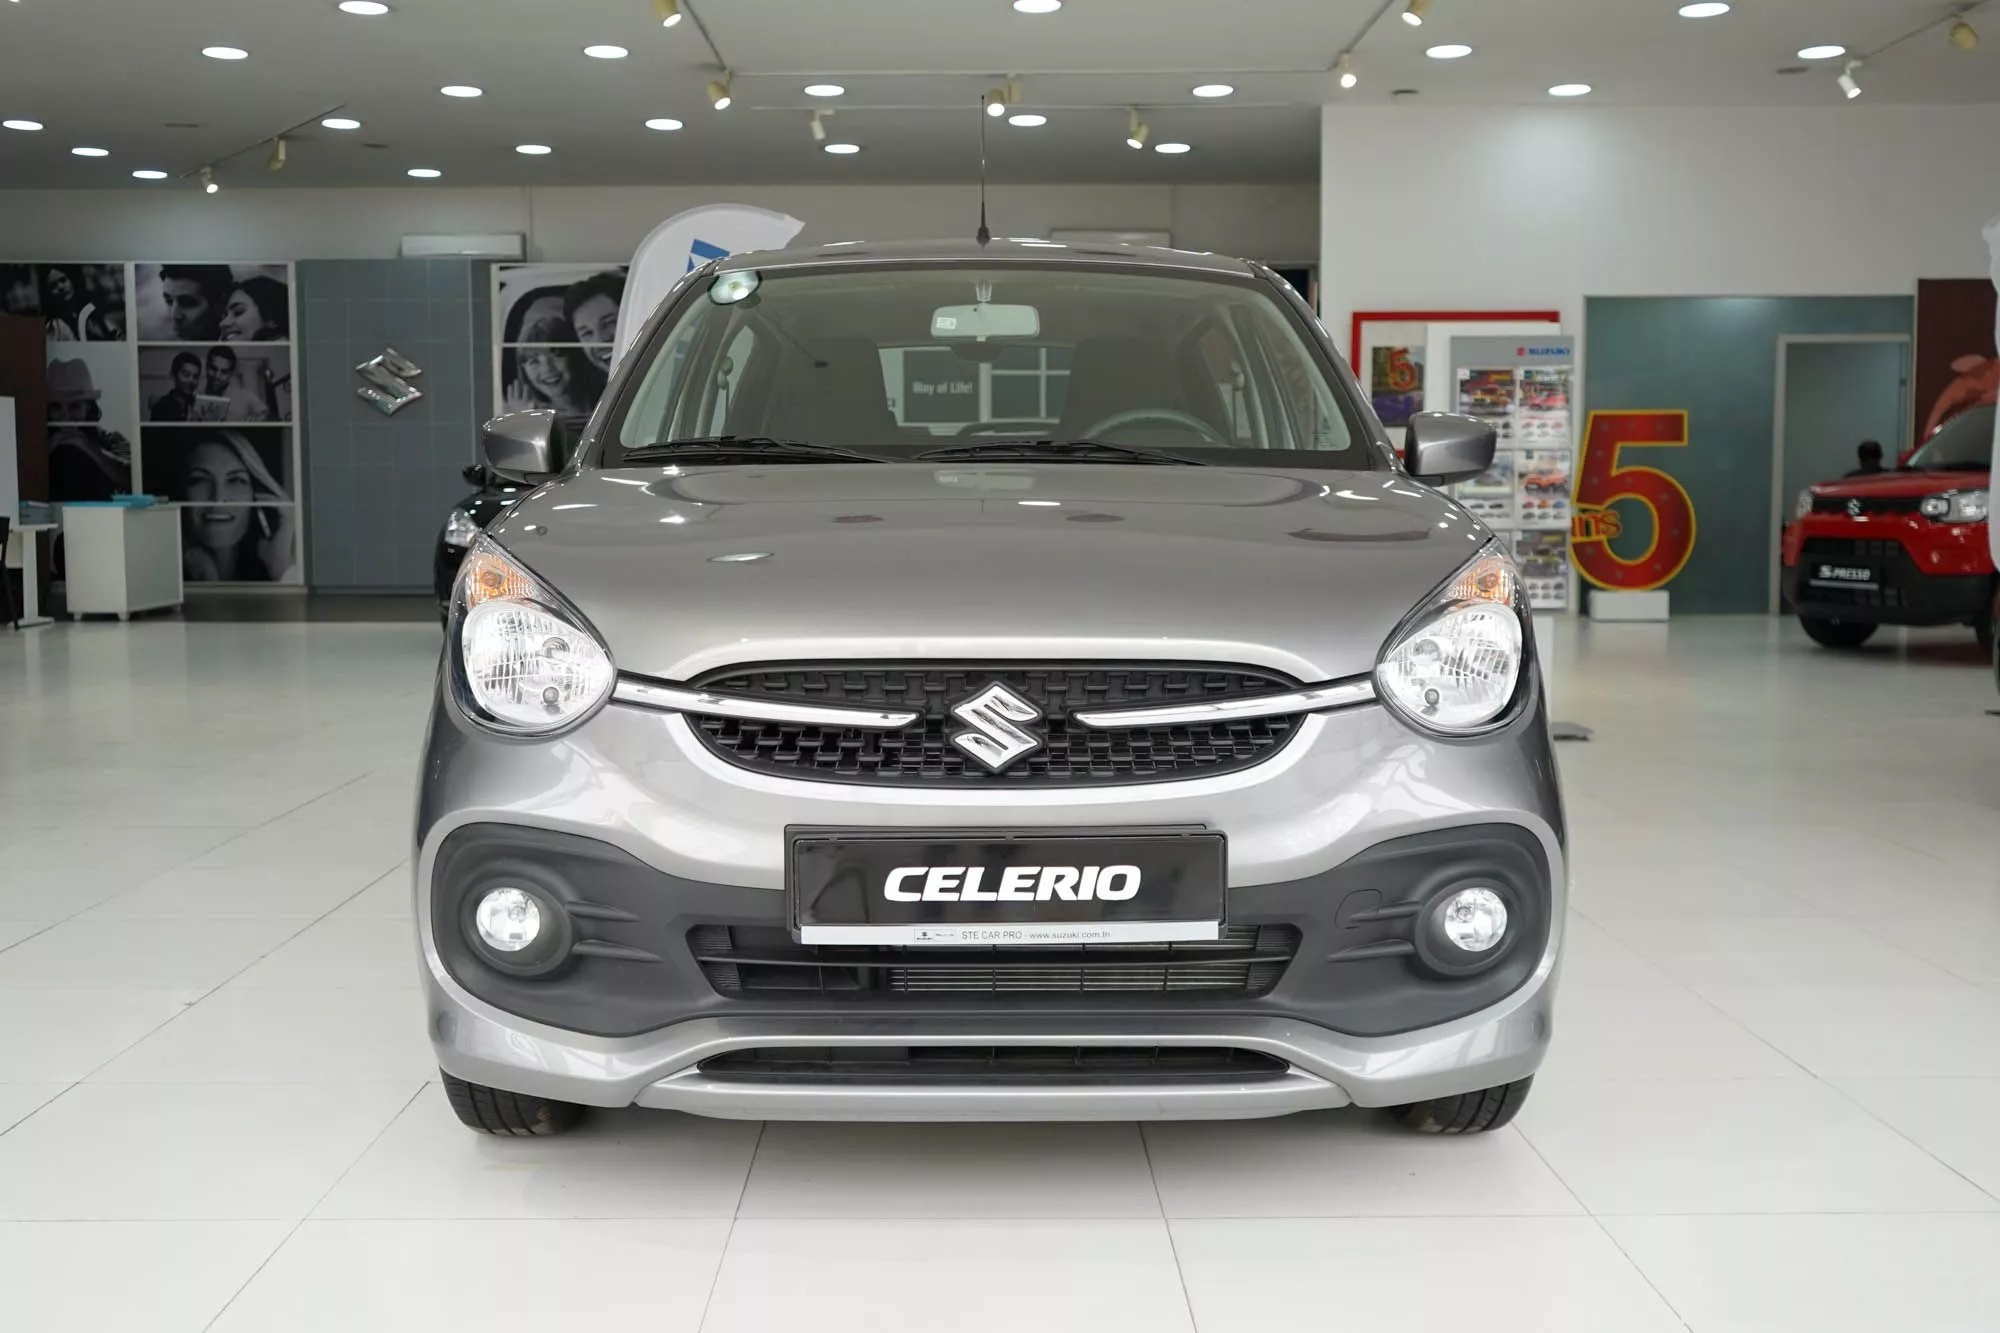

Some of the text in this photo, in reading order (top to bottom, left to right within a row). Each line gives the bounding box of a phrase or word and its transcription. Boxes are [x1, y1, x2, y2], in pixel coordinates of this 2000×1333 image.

[1388, 347, 1418, 391] 5
[1568, 409, 1697, 591] 5
[884, 865, 1142, 902] CELERIO
[961, 930, 979, 940] STE
[981, 930, 1000, 940] CAR
[1003, 930, 1023, 940] PRO
